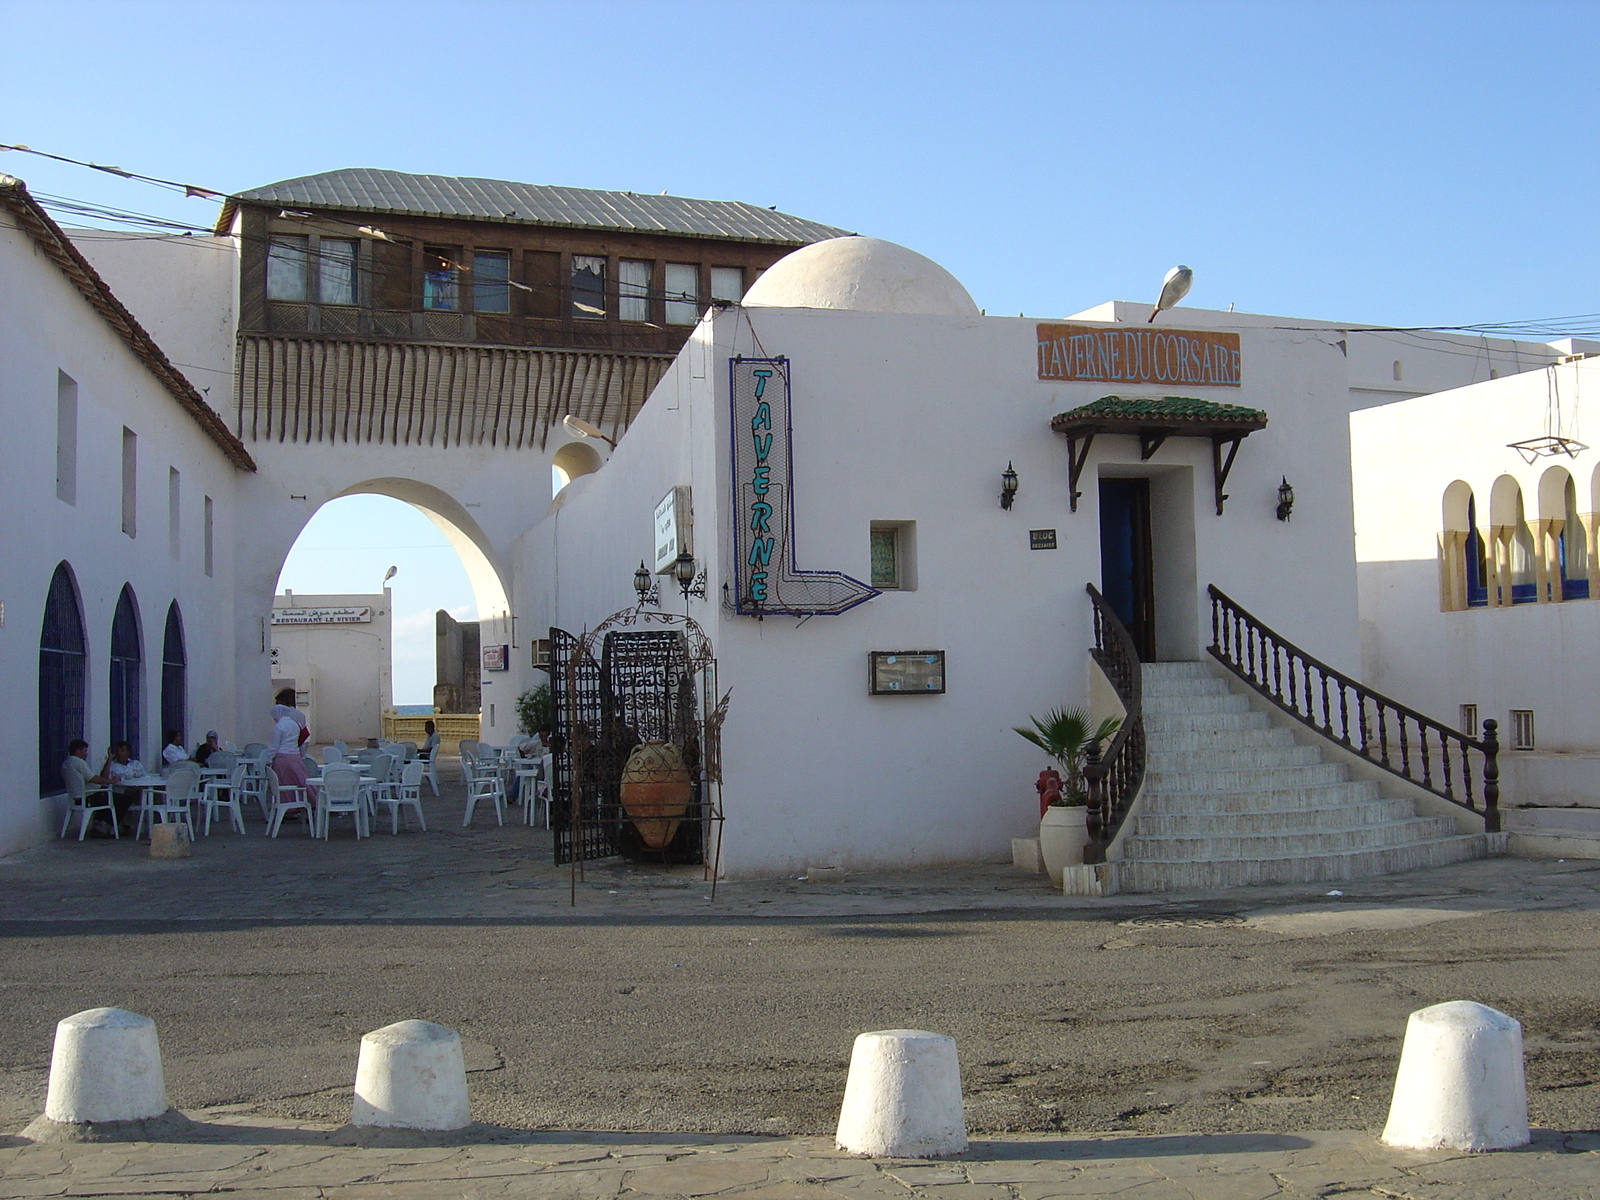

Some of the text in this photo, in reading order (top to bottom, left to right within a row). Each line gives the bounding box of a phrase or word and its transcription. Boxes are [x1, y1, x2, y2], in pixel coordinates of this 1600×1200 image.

[1037, 332, 1241, 384] TAVERNE DU CORSAIRE
[749, 370, 774, 600] TAVERNE
[309, 609, 330, 619] حوض
[333, 608, 355, 617] مطعم
